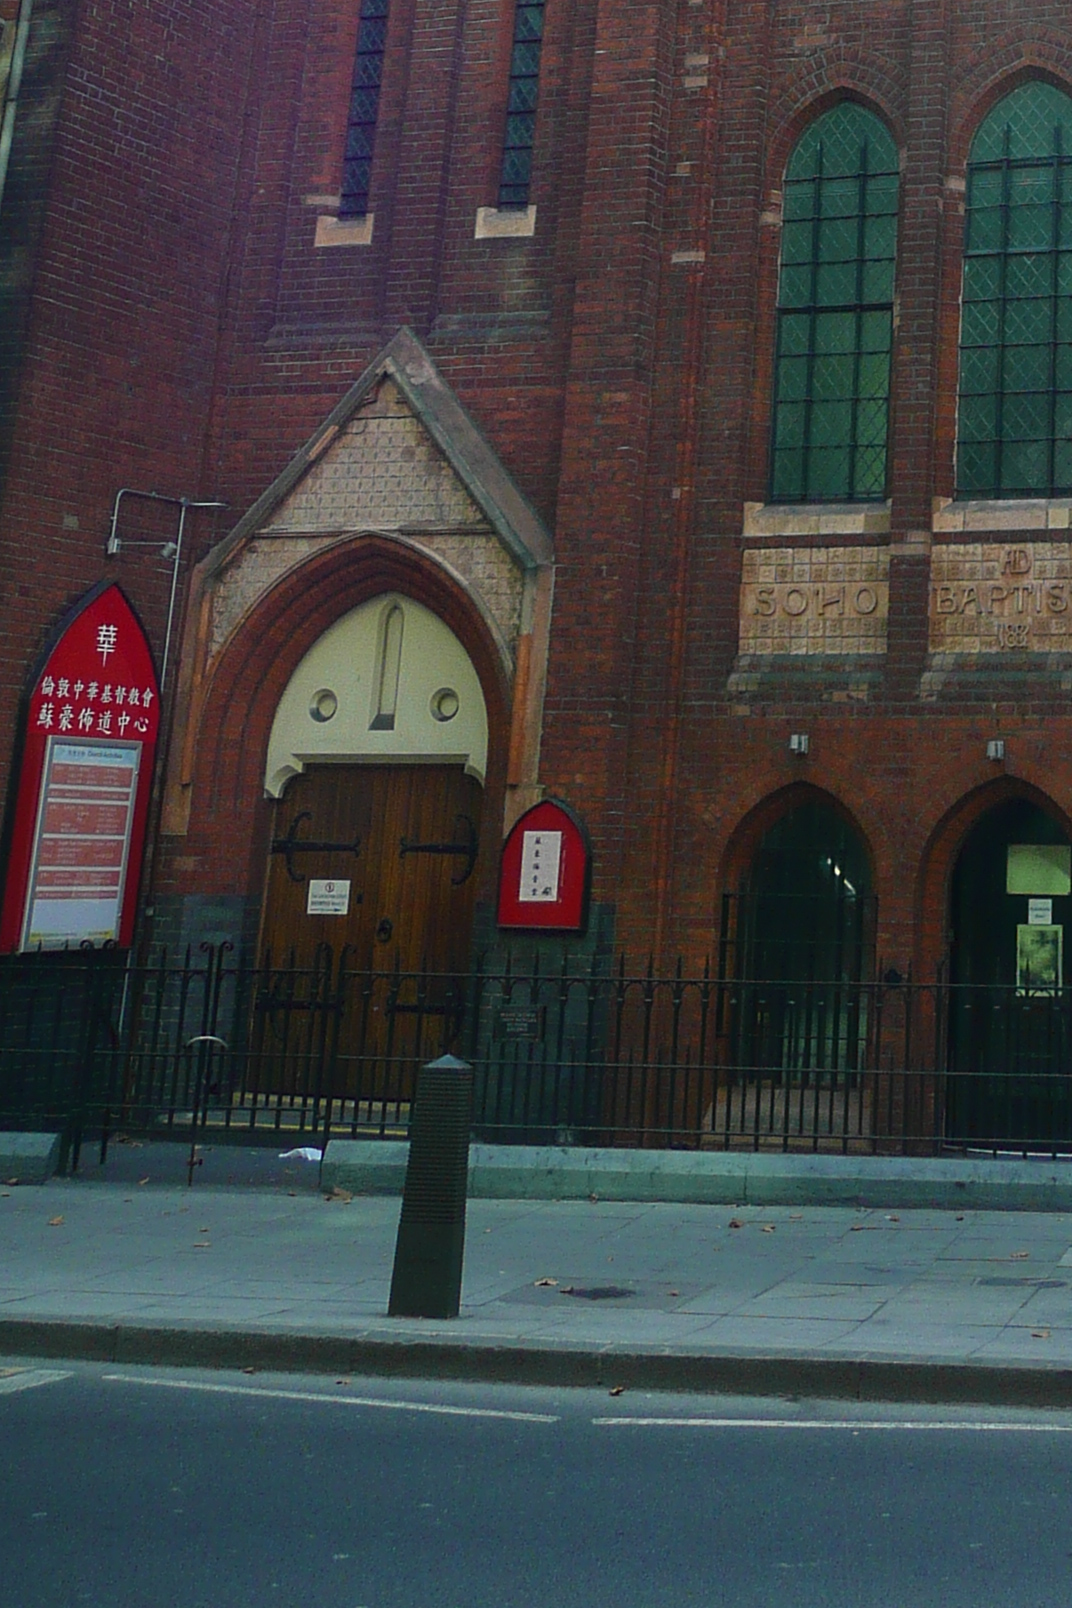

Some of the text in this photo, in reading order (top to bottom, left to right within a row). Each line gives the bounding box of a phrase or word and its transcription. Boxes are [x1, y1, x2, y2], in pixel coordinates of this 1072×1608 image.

[753, 586, 878, 616] SOHO
[41, 675, 154, 708] 倫敦中華基督教會
[37, 702, 150, 736] 蘇豪佈道中心
